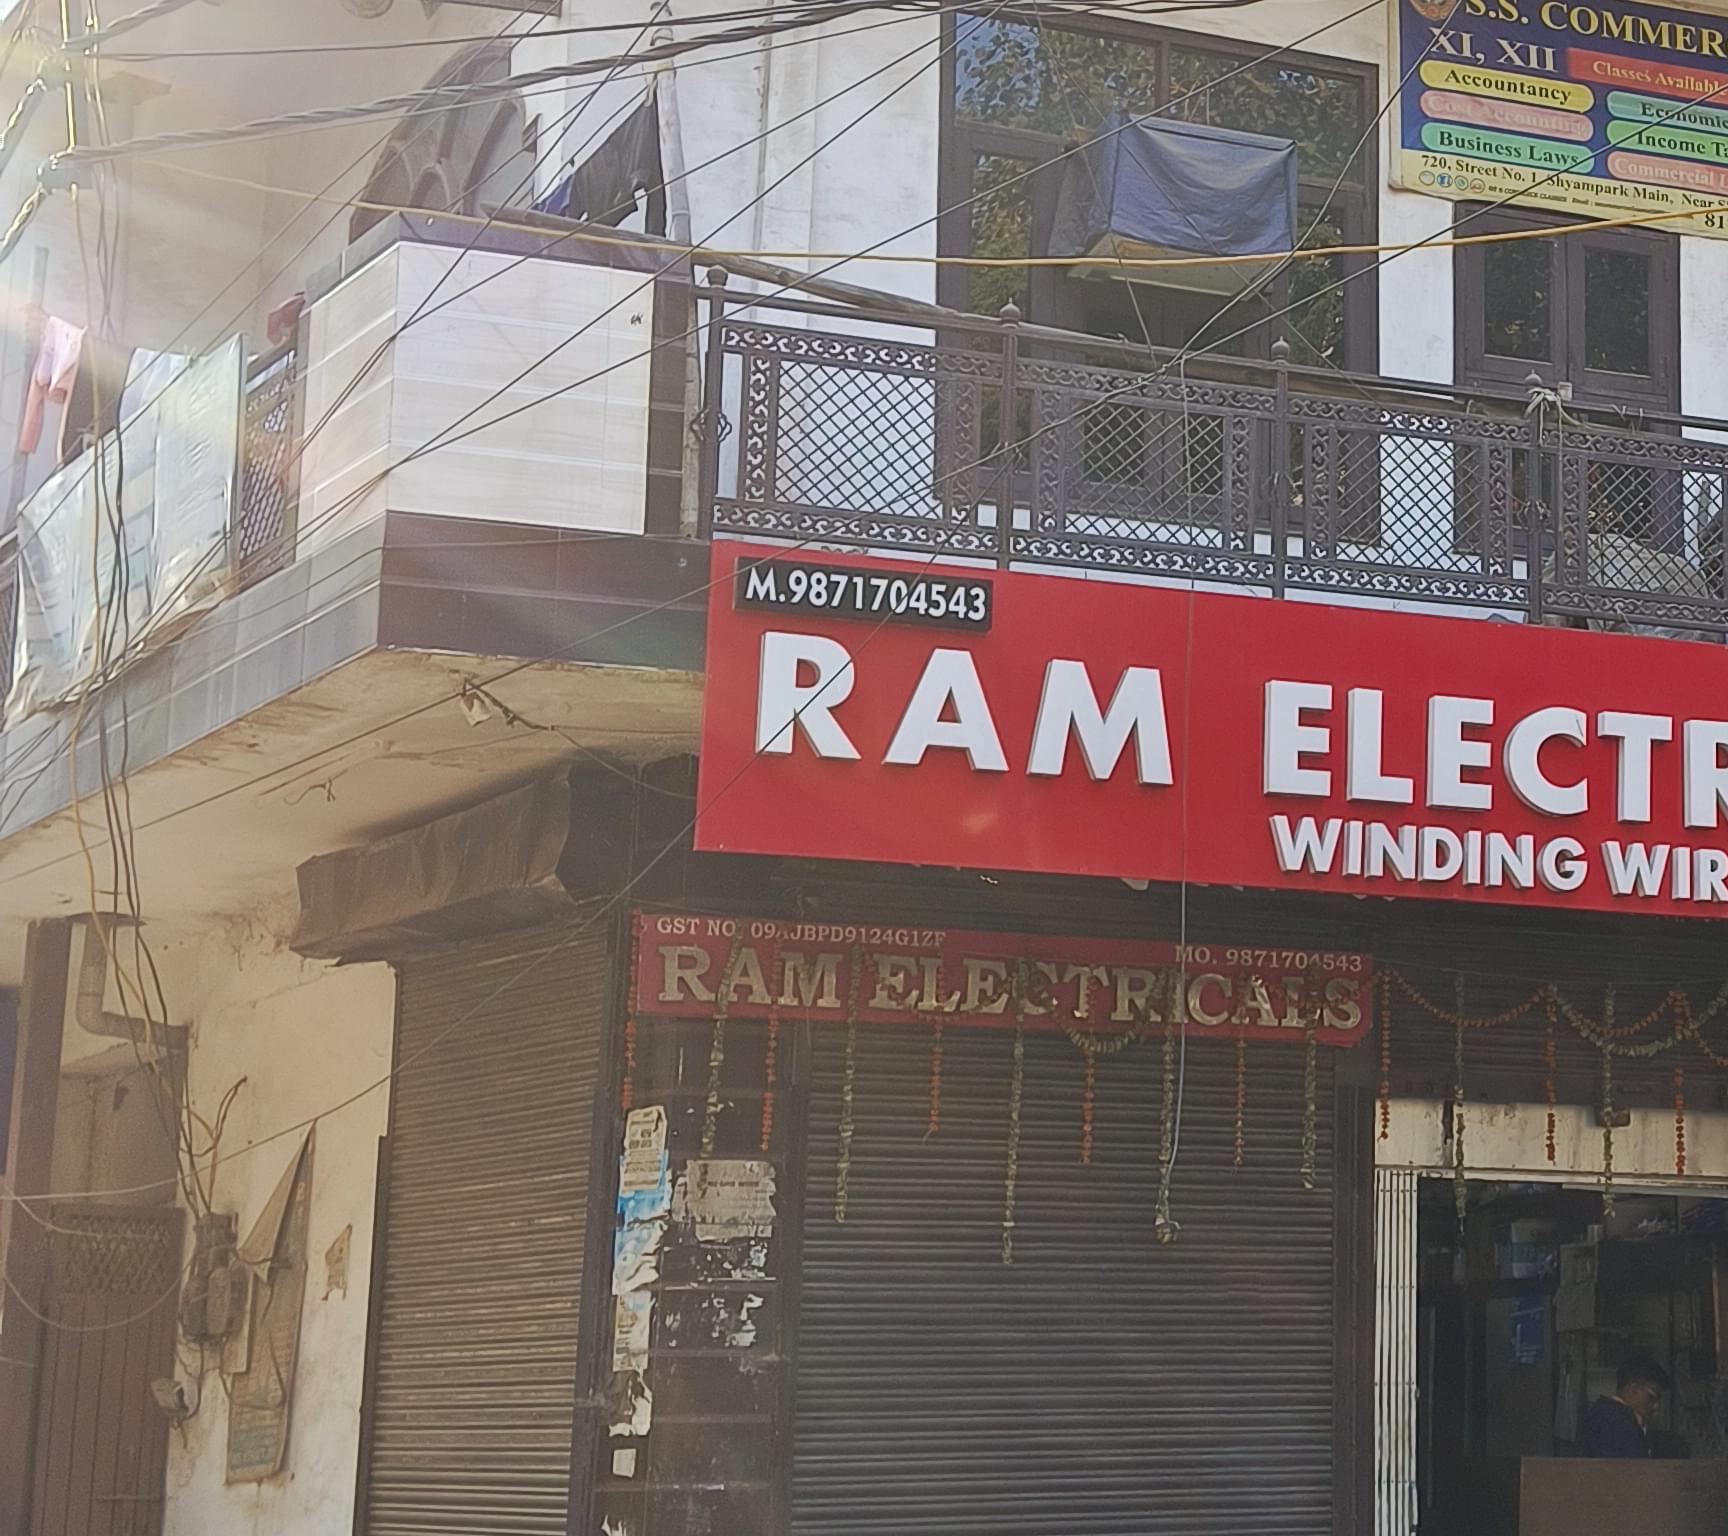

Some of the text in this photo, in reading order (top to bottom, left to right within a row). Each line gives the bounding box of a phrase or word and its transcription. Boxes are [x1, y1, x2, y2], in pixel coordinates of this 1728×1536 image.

[1496, 38, 1558, 73] XII
[1592, 60, 1651, 82] Classes
[1444, 68, 1572, 106] Accountancy
[1438, 130, 1580, 166] Business Laws
[1635, 131, 1707, 156] Income
[1421, 155, 1451, 171] 720,
[1455, 160, 1498, 178] Street
[1501, 167, 1526, 183] No.
[1546, 175, 1629, 200] Shyampark
[1632, 187, 1675, 205] Main,
[1681, 193, 1715, 209] Near
[745, 566, 987, 622] M.9871704543
[756, 631, 1174, 786] RAM
[1269, 814, 1589, 893] WINDING
[656, 917, 700, 936] GST
[1175, 944, 1217, 965] MO.
[657, 944, 844, 1009] RAM
